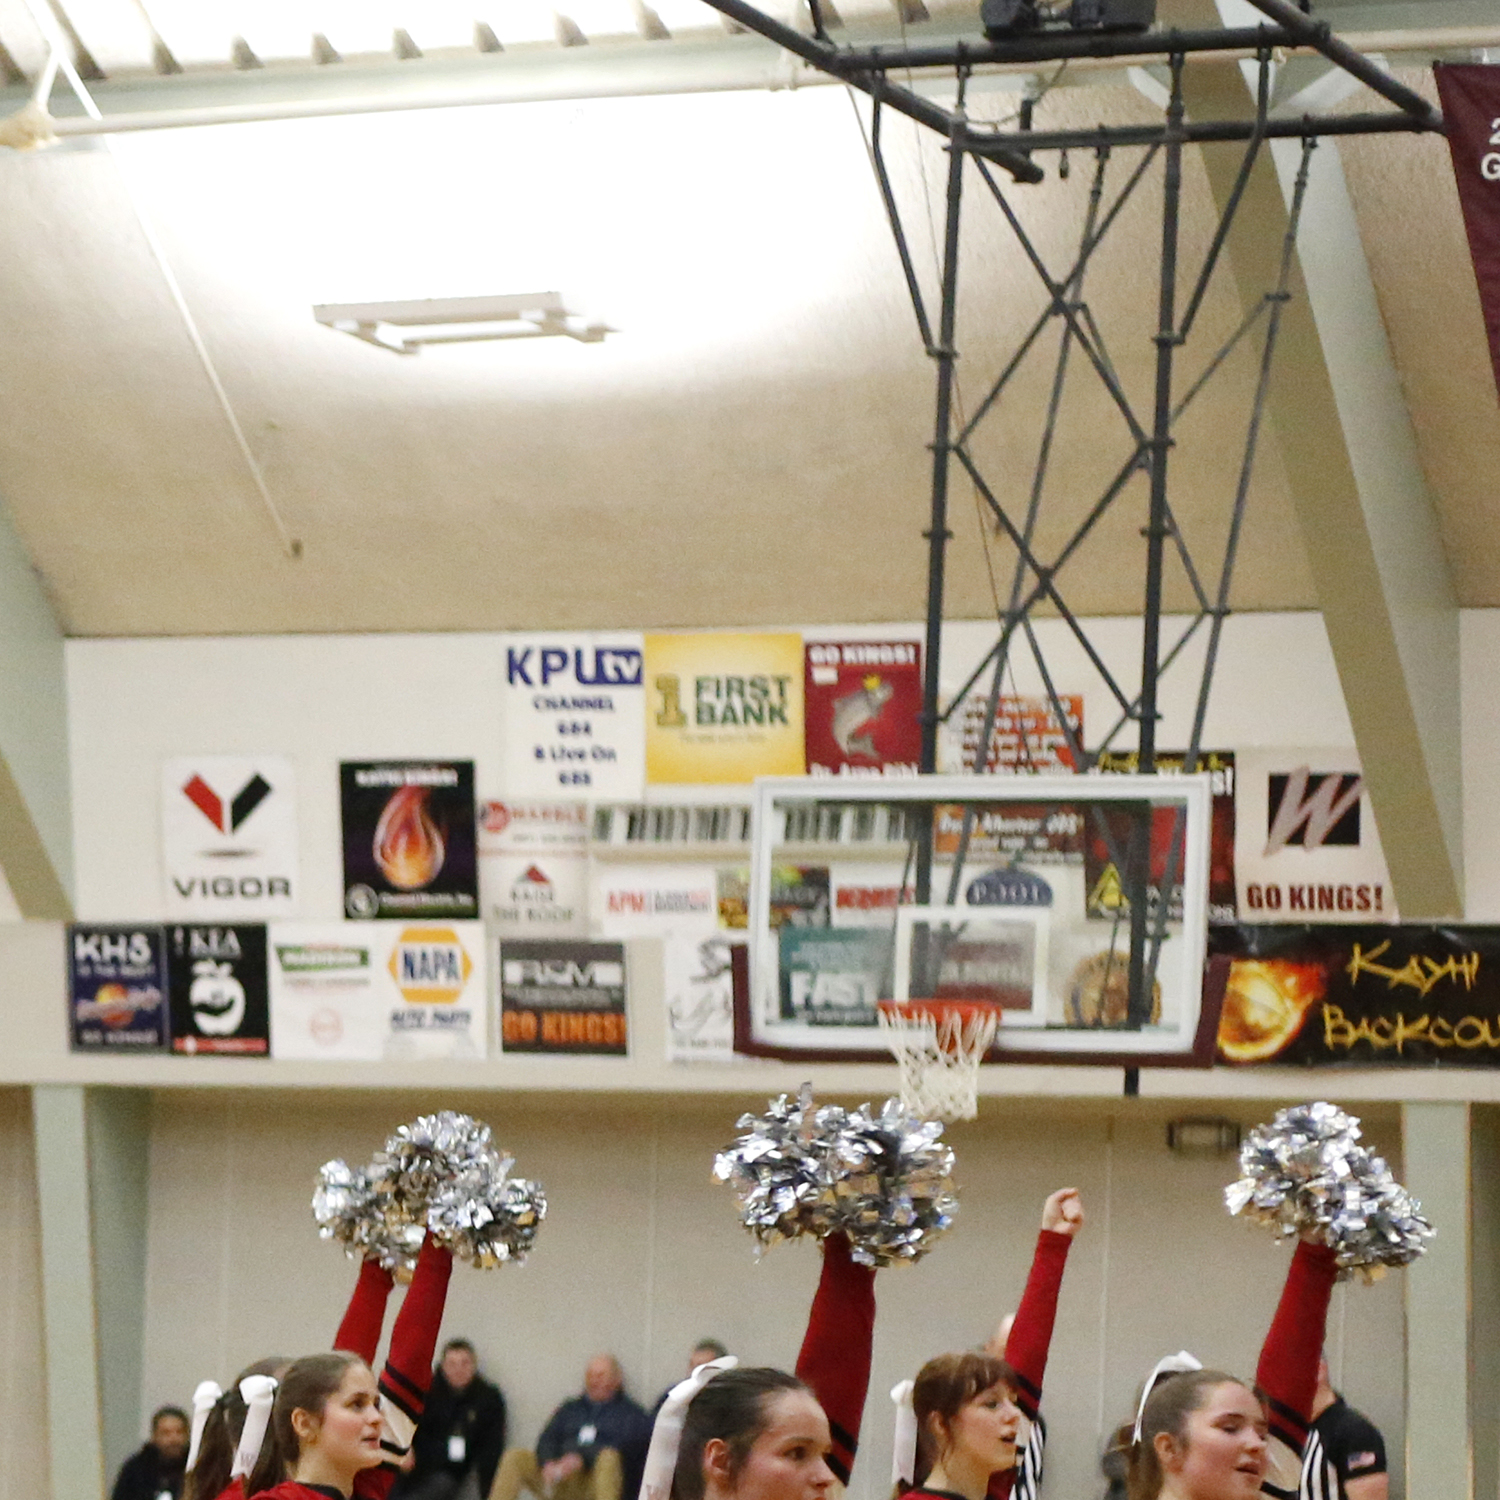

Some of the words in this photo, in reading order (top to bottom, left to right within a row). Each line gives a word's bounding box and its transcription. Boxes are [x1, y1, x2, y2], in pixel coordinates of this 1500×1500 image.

[696, 675, 791, 700] FIRST
[695, 701, 790, 726] BANK
[173, 876, 292, 898] VIGOR
[1247, 884, 1282, 911] GO
[1289, 884, 1384, 912] KINGS!
[74, 931, 152, 966] KHS
[402, 948, 461, 981] NAPA
